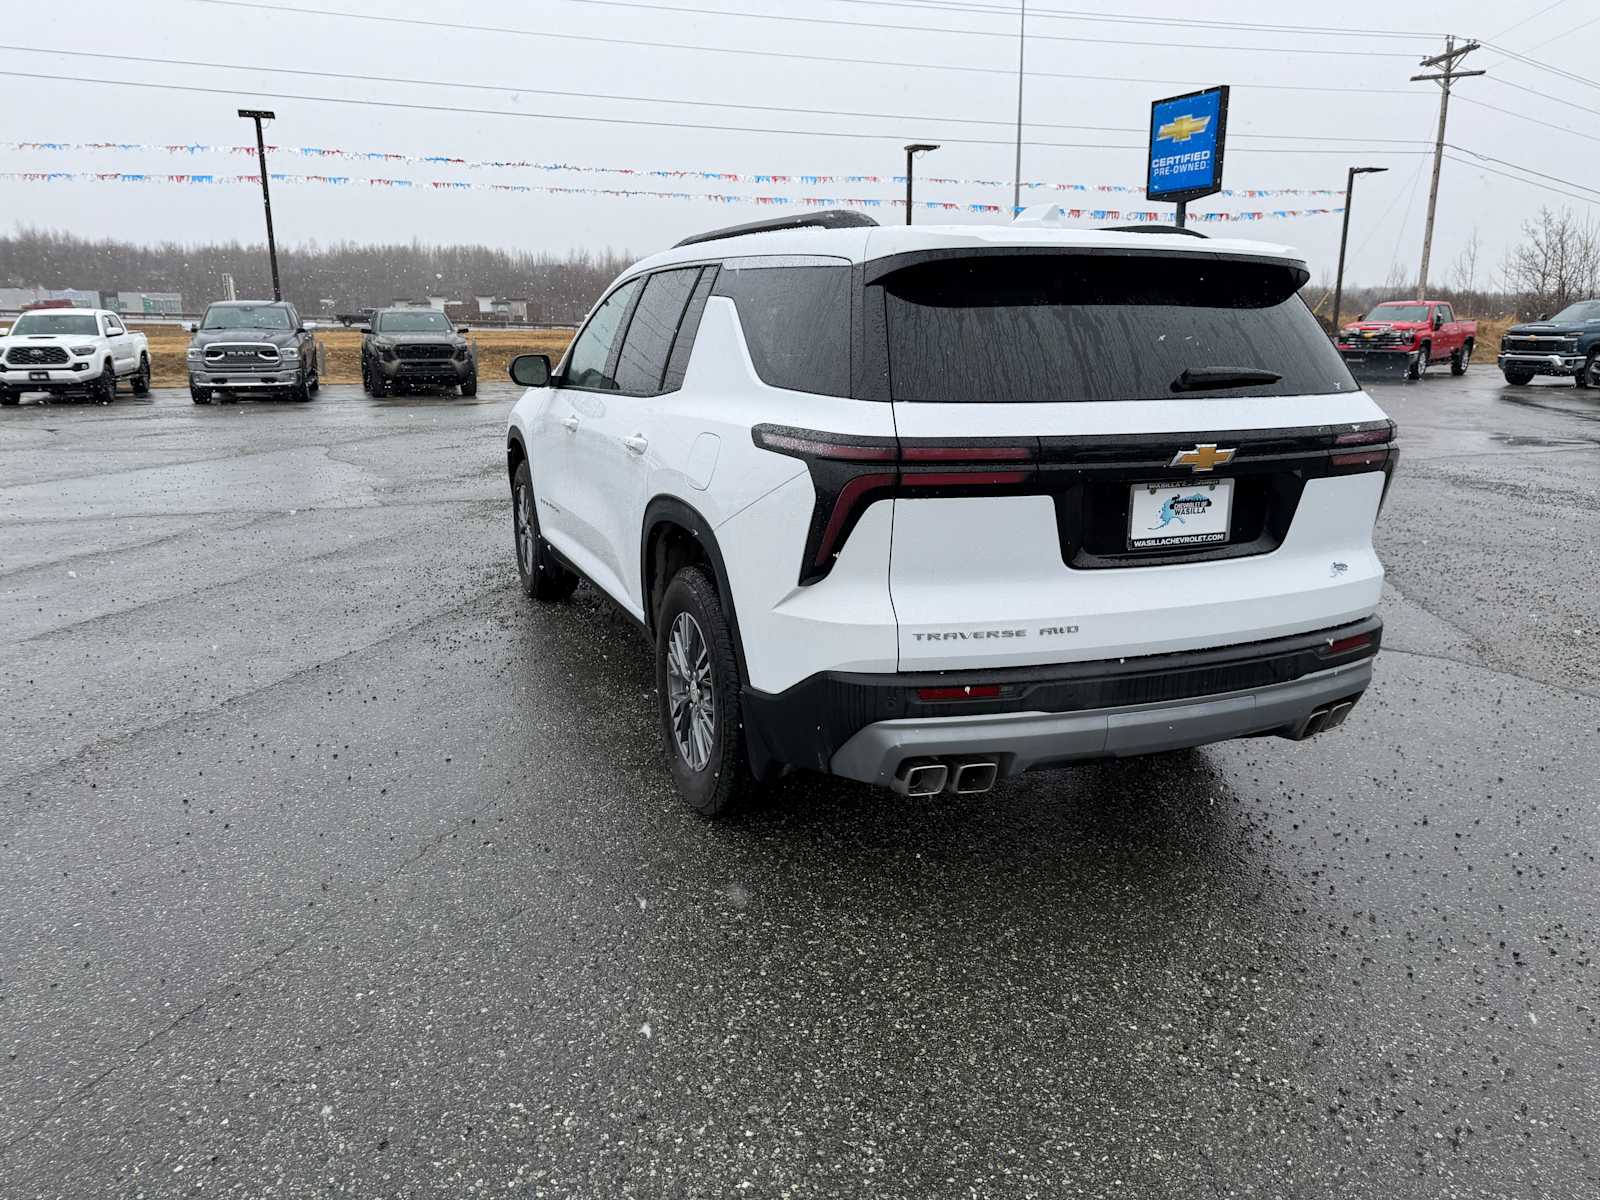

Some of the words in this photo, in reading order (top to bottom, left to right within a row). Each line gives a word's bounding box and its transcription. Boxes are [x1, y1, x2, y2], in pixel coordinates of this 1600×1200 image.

[1152, 150, 1210, 168] CERTIFIED
[1174, 506, 1206, 516] WASILLA
[1133, 534, 1224, 548] WASILLACHEVROLET.COM
[911, 629, 1027, 641] TRAVERSE
[1039, 625, 1080, 636] AWD
